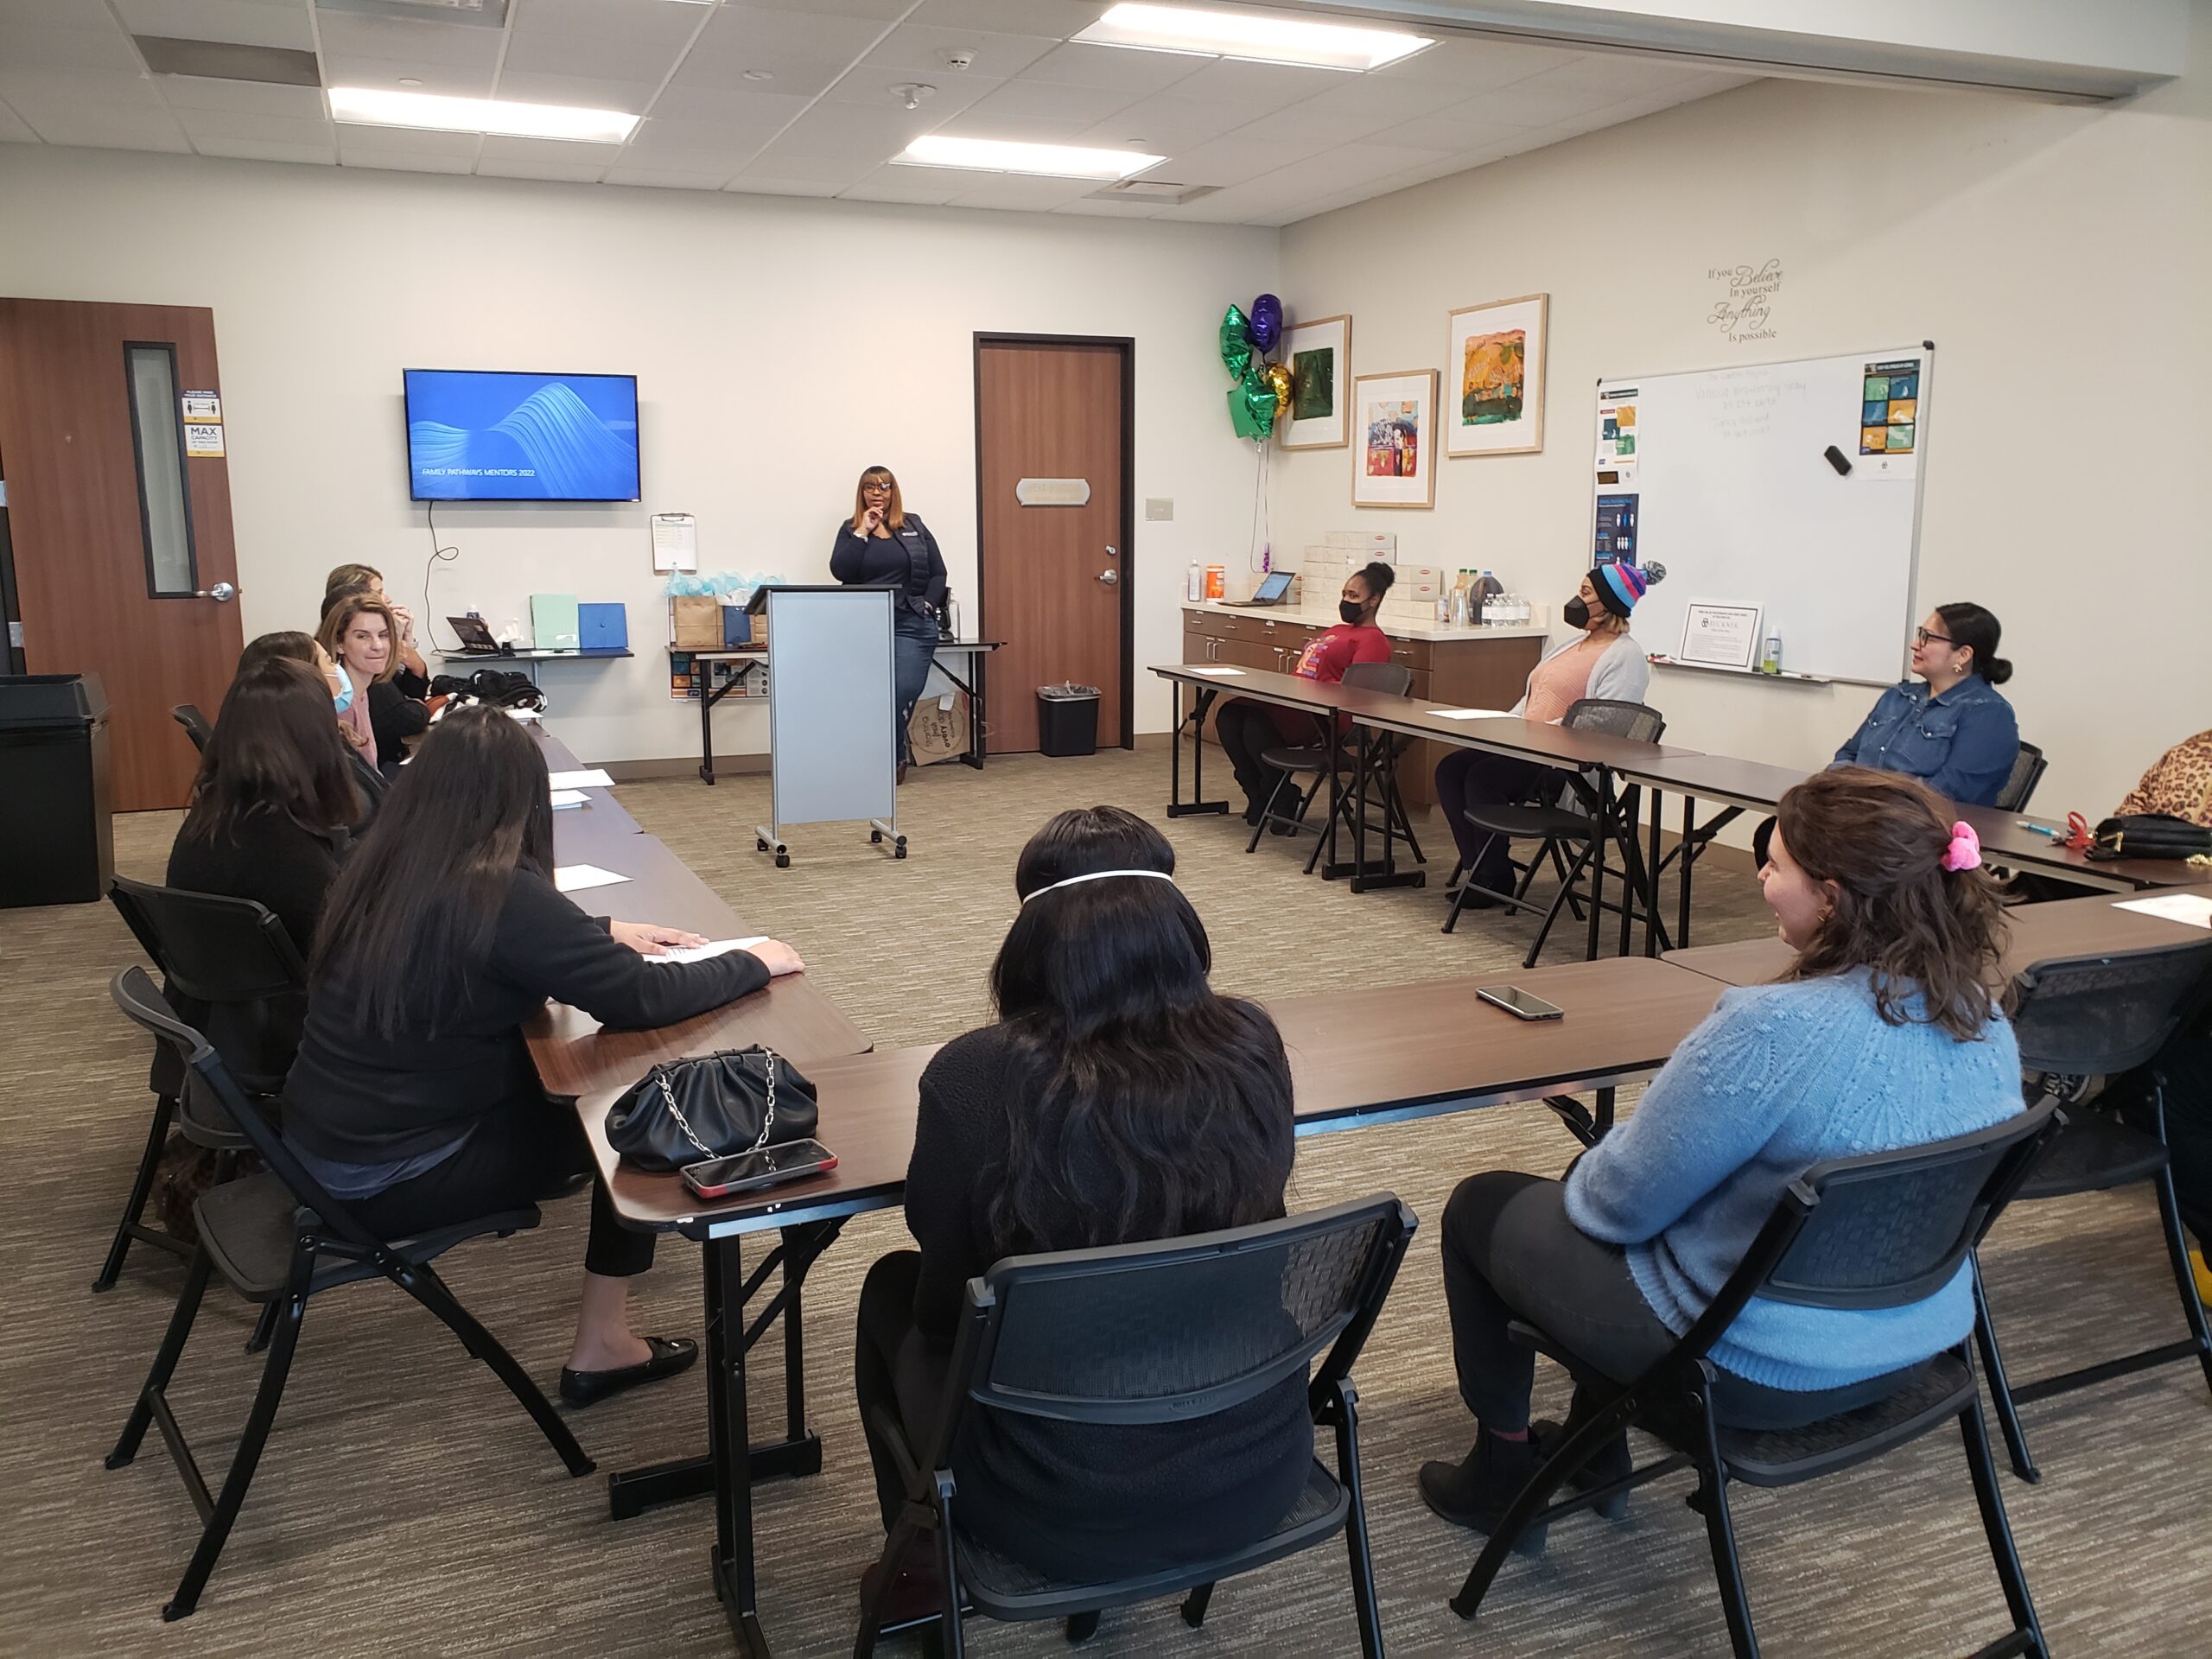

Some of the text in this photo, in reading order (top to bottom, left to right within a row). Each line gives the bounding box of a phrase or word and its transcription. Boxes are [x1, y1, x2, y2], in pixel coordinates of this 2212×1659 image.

[1708, 258, 1783, 287] If you Believe
[1730, 282, 1782, 298] In yourself
[1707, 294, 1770, 334] Anything
[1729, 328, 1777, 343] Is possible
[191, 427, 218, 436] MAX
[422, 467, 446, 476] FAMILY
[447, 467, 483, 476] PATHWAYS
[484, 468, 518, 477] MENTORS
[939, 725, 950, 748] every
